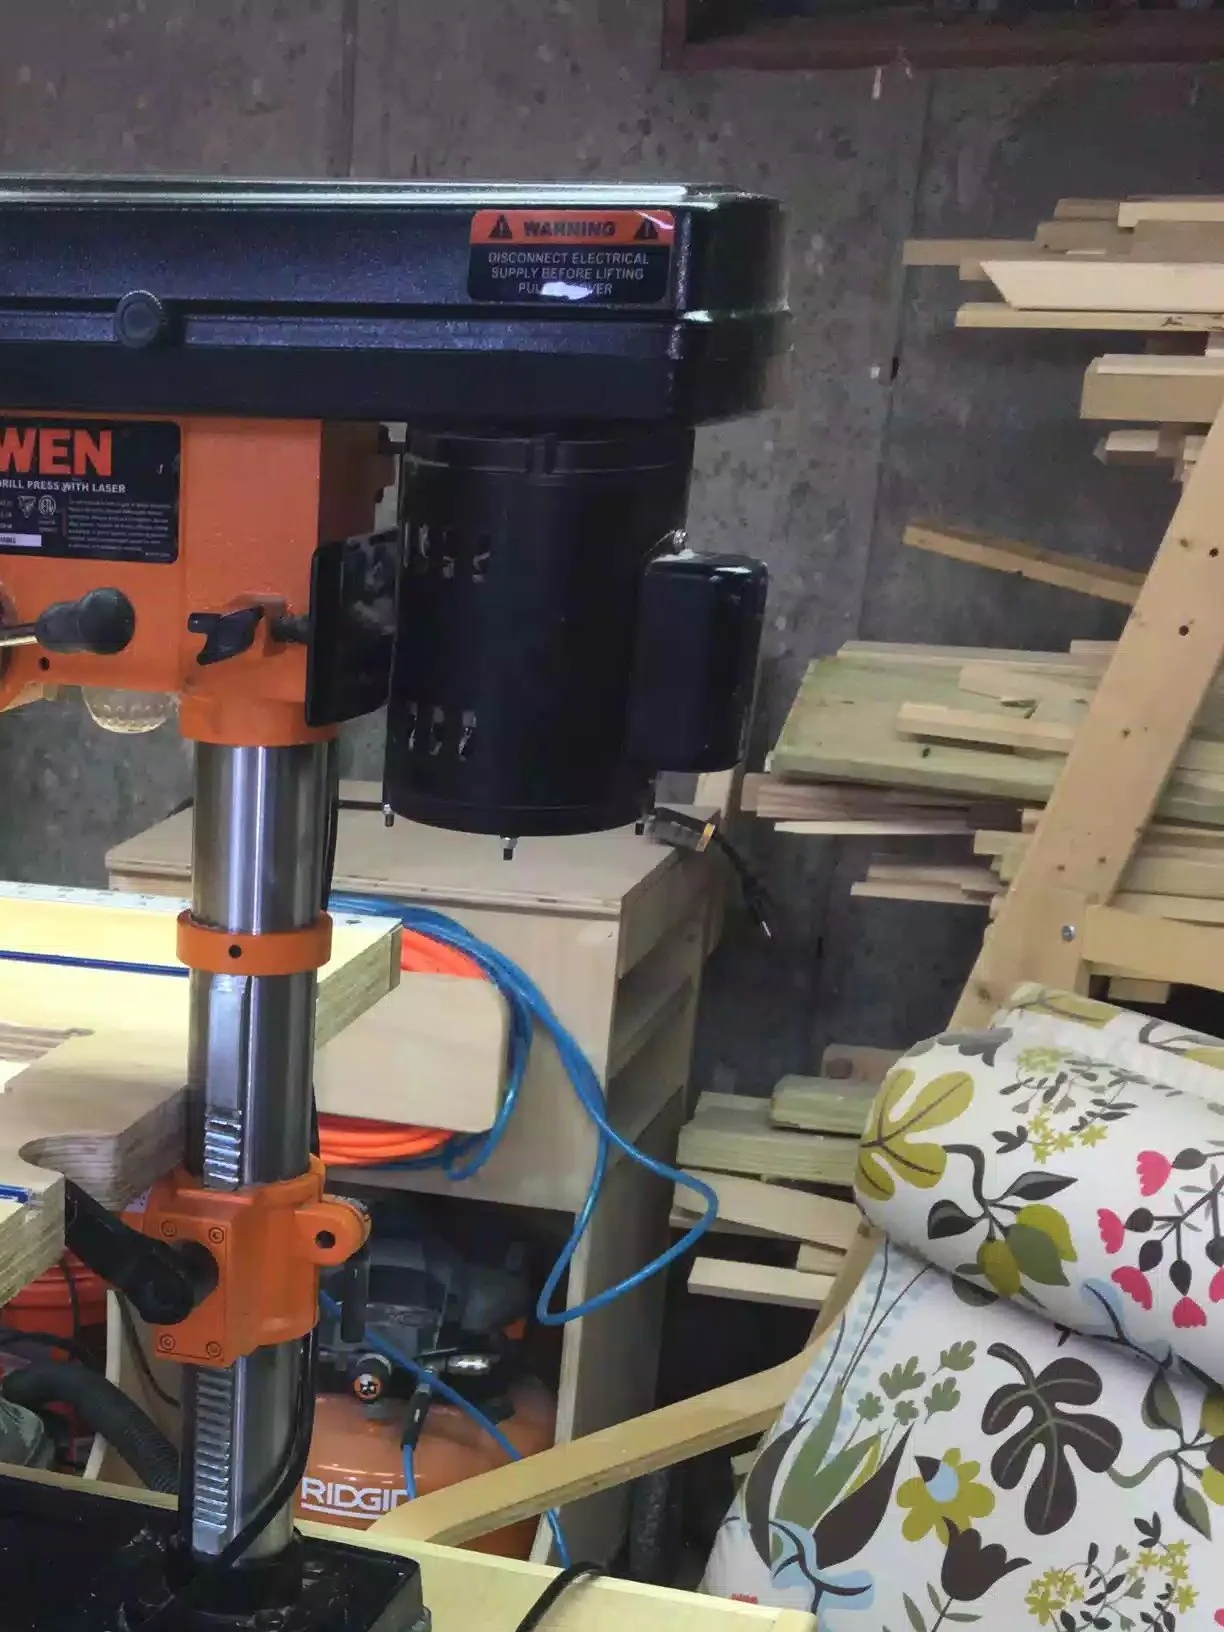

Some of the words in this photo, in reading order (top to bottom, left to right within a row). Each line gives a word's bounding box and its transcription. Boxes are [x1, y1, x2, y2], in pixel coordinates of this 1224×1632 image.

[524, 220, 616, 237] WARNING
[488, 251, 567, 264] DISCONNECT
[572, 251, 649, 265] ELECTRICAL
[491, 267, 541, 279] SUPPLY
[542, 267, 593, 280] BEFORE
[596, 268, 644, 280] LIFTING
[27, 480, 59, 491] PRESS
[61, 481, 89, 492] WITH
[92, 483, 126, 494] LASER
